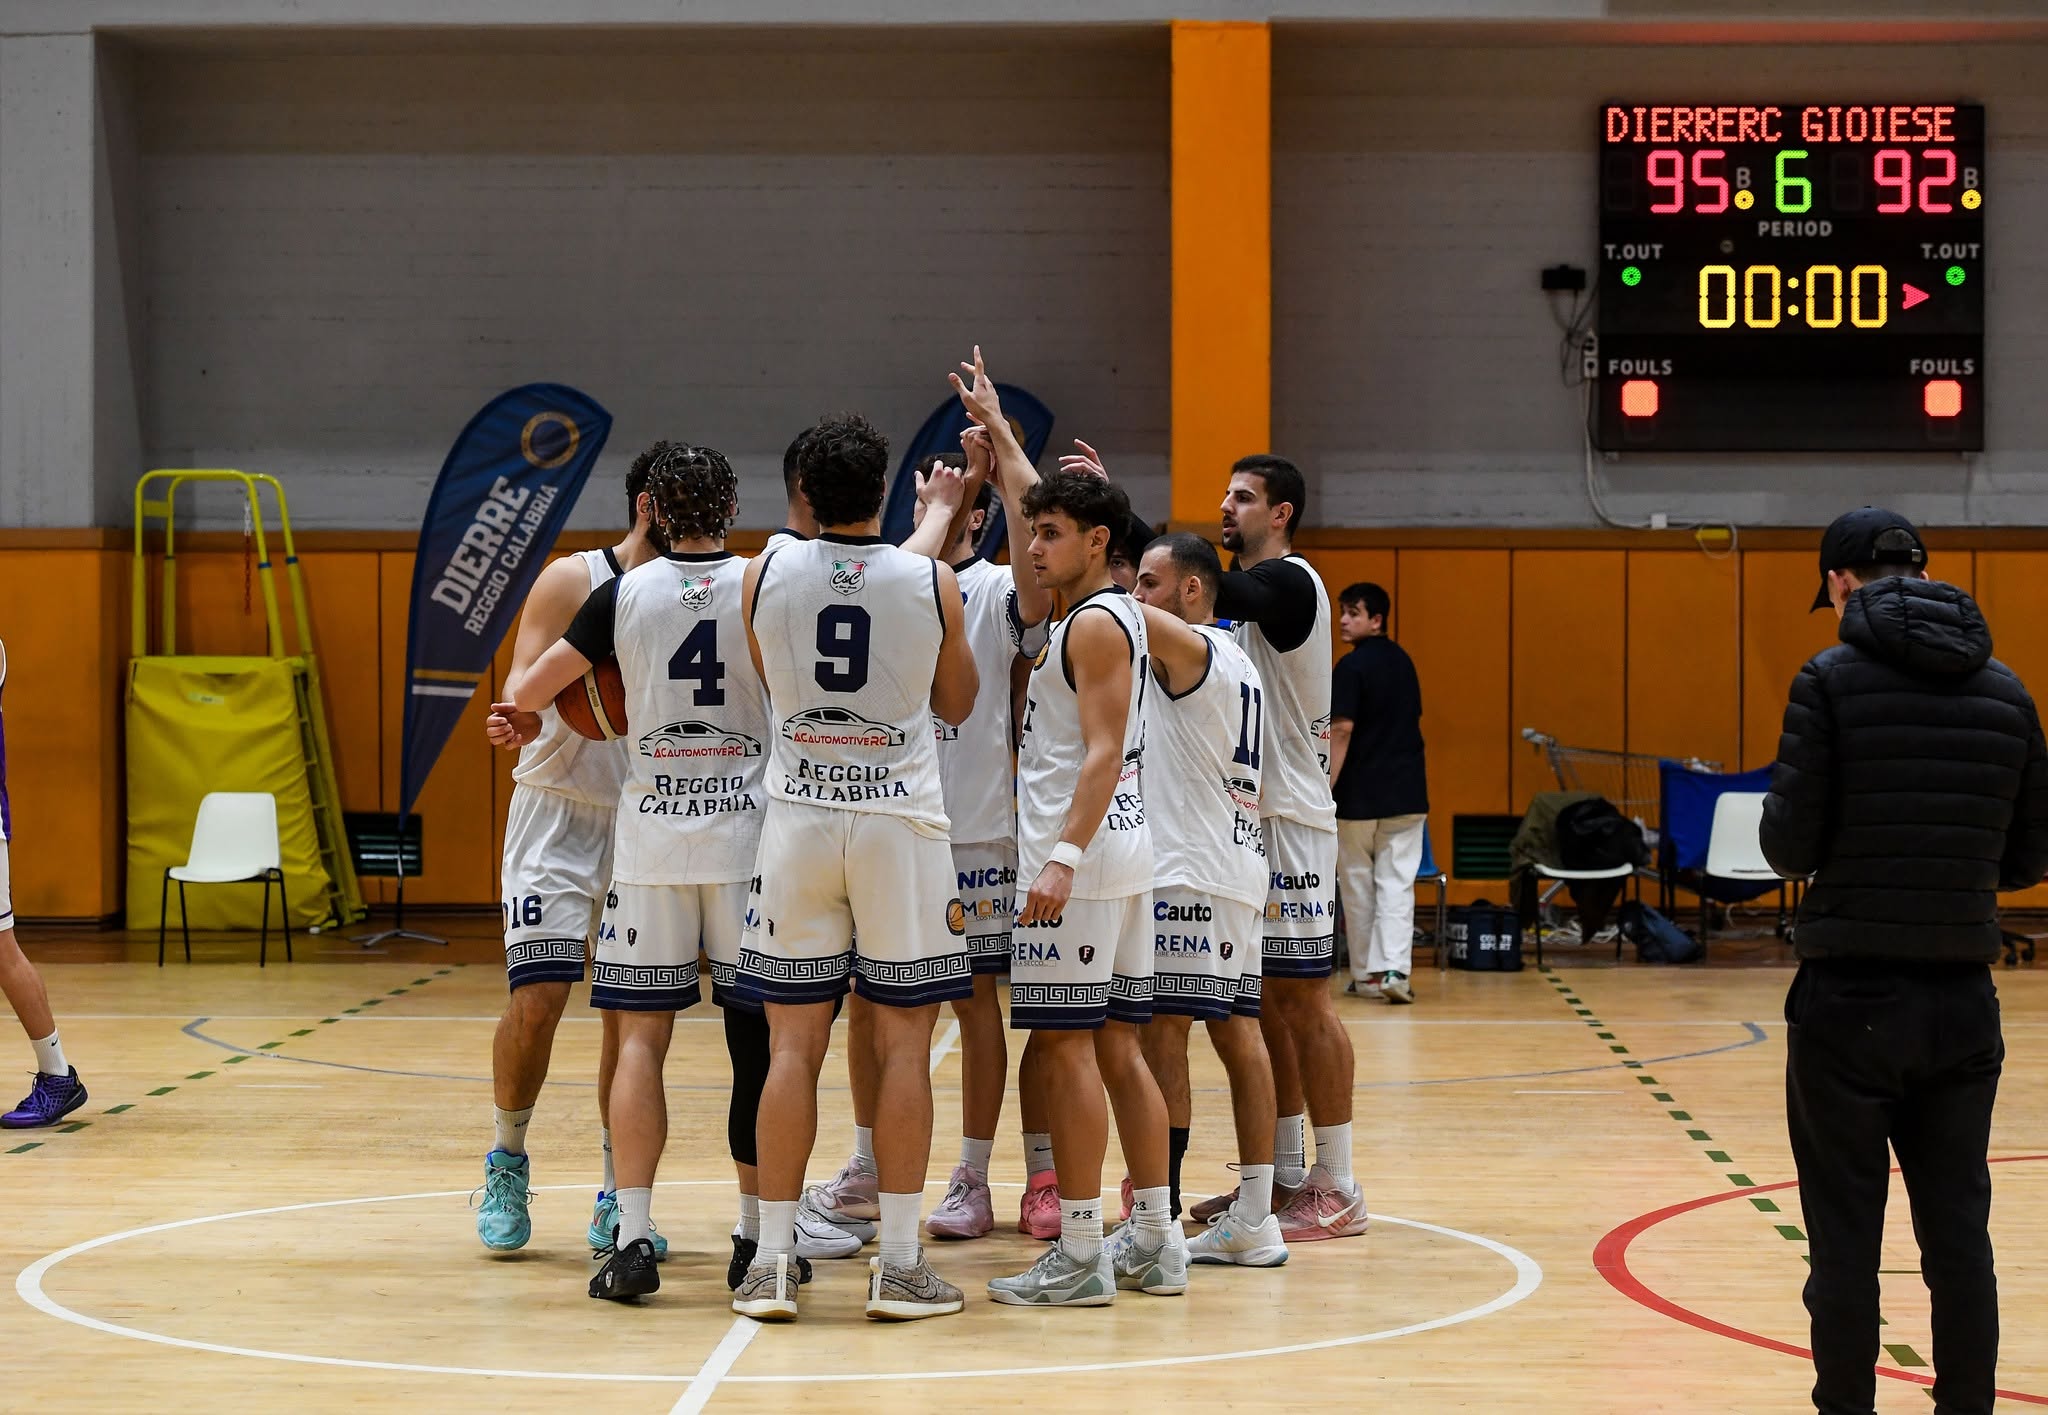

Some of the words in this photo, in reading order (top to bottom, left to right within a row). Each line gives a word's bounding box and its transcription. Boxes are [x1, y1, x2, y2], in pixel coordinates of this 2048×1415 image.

[1606, 106, 1783, 142] DIERRERC
[1801, 106, 1956, 141] GIOIESE
[1647, 149, 1729, 213] 95
[1736, 167, 1752, 188] B
[1775, 149, 1812, 213] 6
[1874, 149, 1957, 213] 92
[1963, 167, 1979, 188] B
[1758, 221, 1833, 237] PERIOD
[1605, 244, 1664, 260] T.OUT
[1921, 243, 1980, 260] T.OUT
[1698, 264, 1888, 328] 00:00
[1608, 359, 1673, 375] FOULS
[1910, 359, 1975, 375] FOULS
[430, 475, 531, 616] DIERRE
[463, 568, 510, 636] REGGIO
[501, 484, 559, 570] CALABRIA
[668, 619, 725, 706] 4
[814, 604, 872, 693] 9
[1232, 681, 1262, 770] 11
[784, 774, 910, 802] CALABRIA
[638, 794, 757, 817] CALABRIA
[1071, 1210, 1093, 1219] 23
